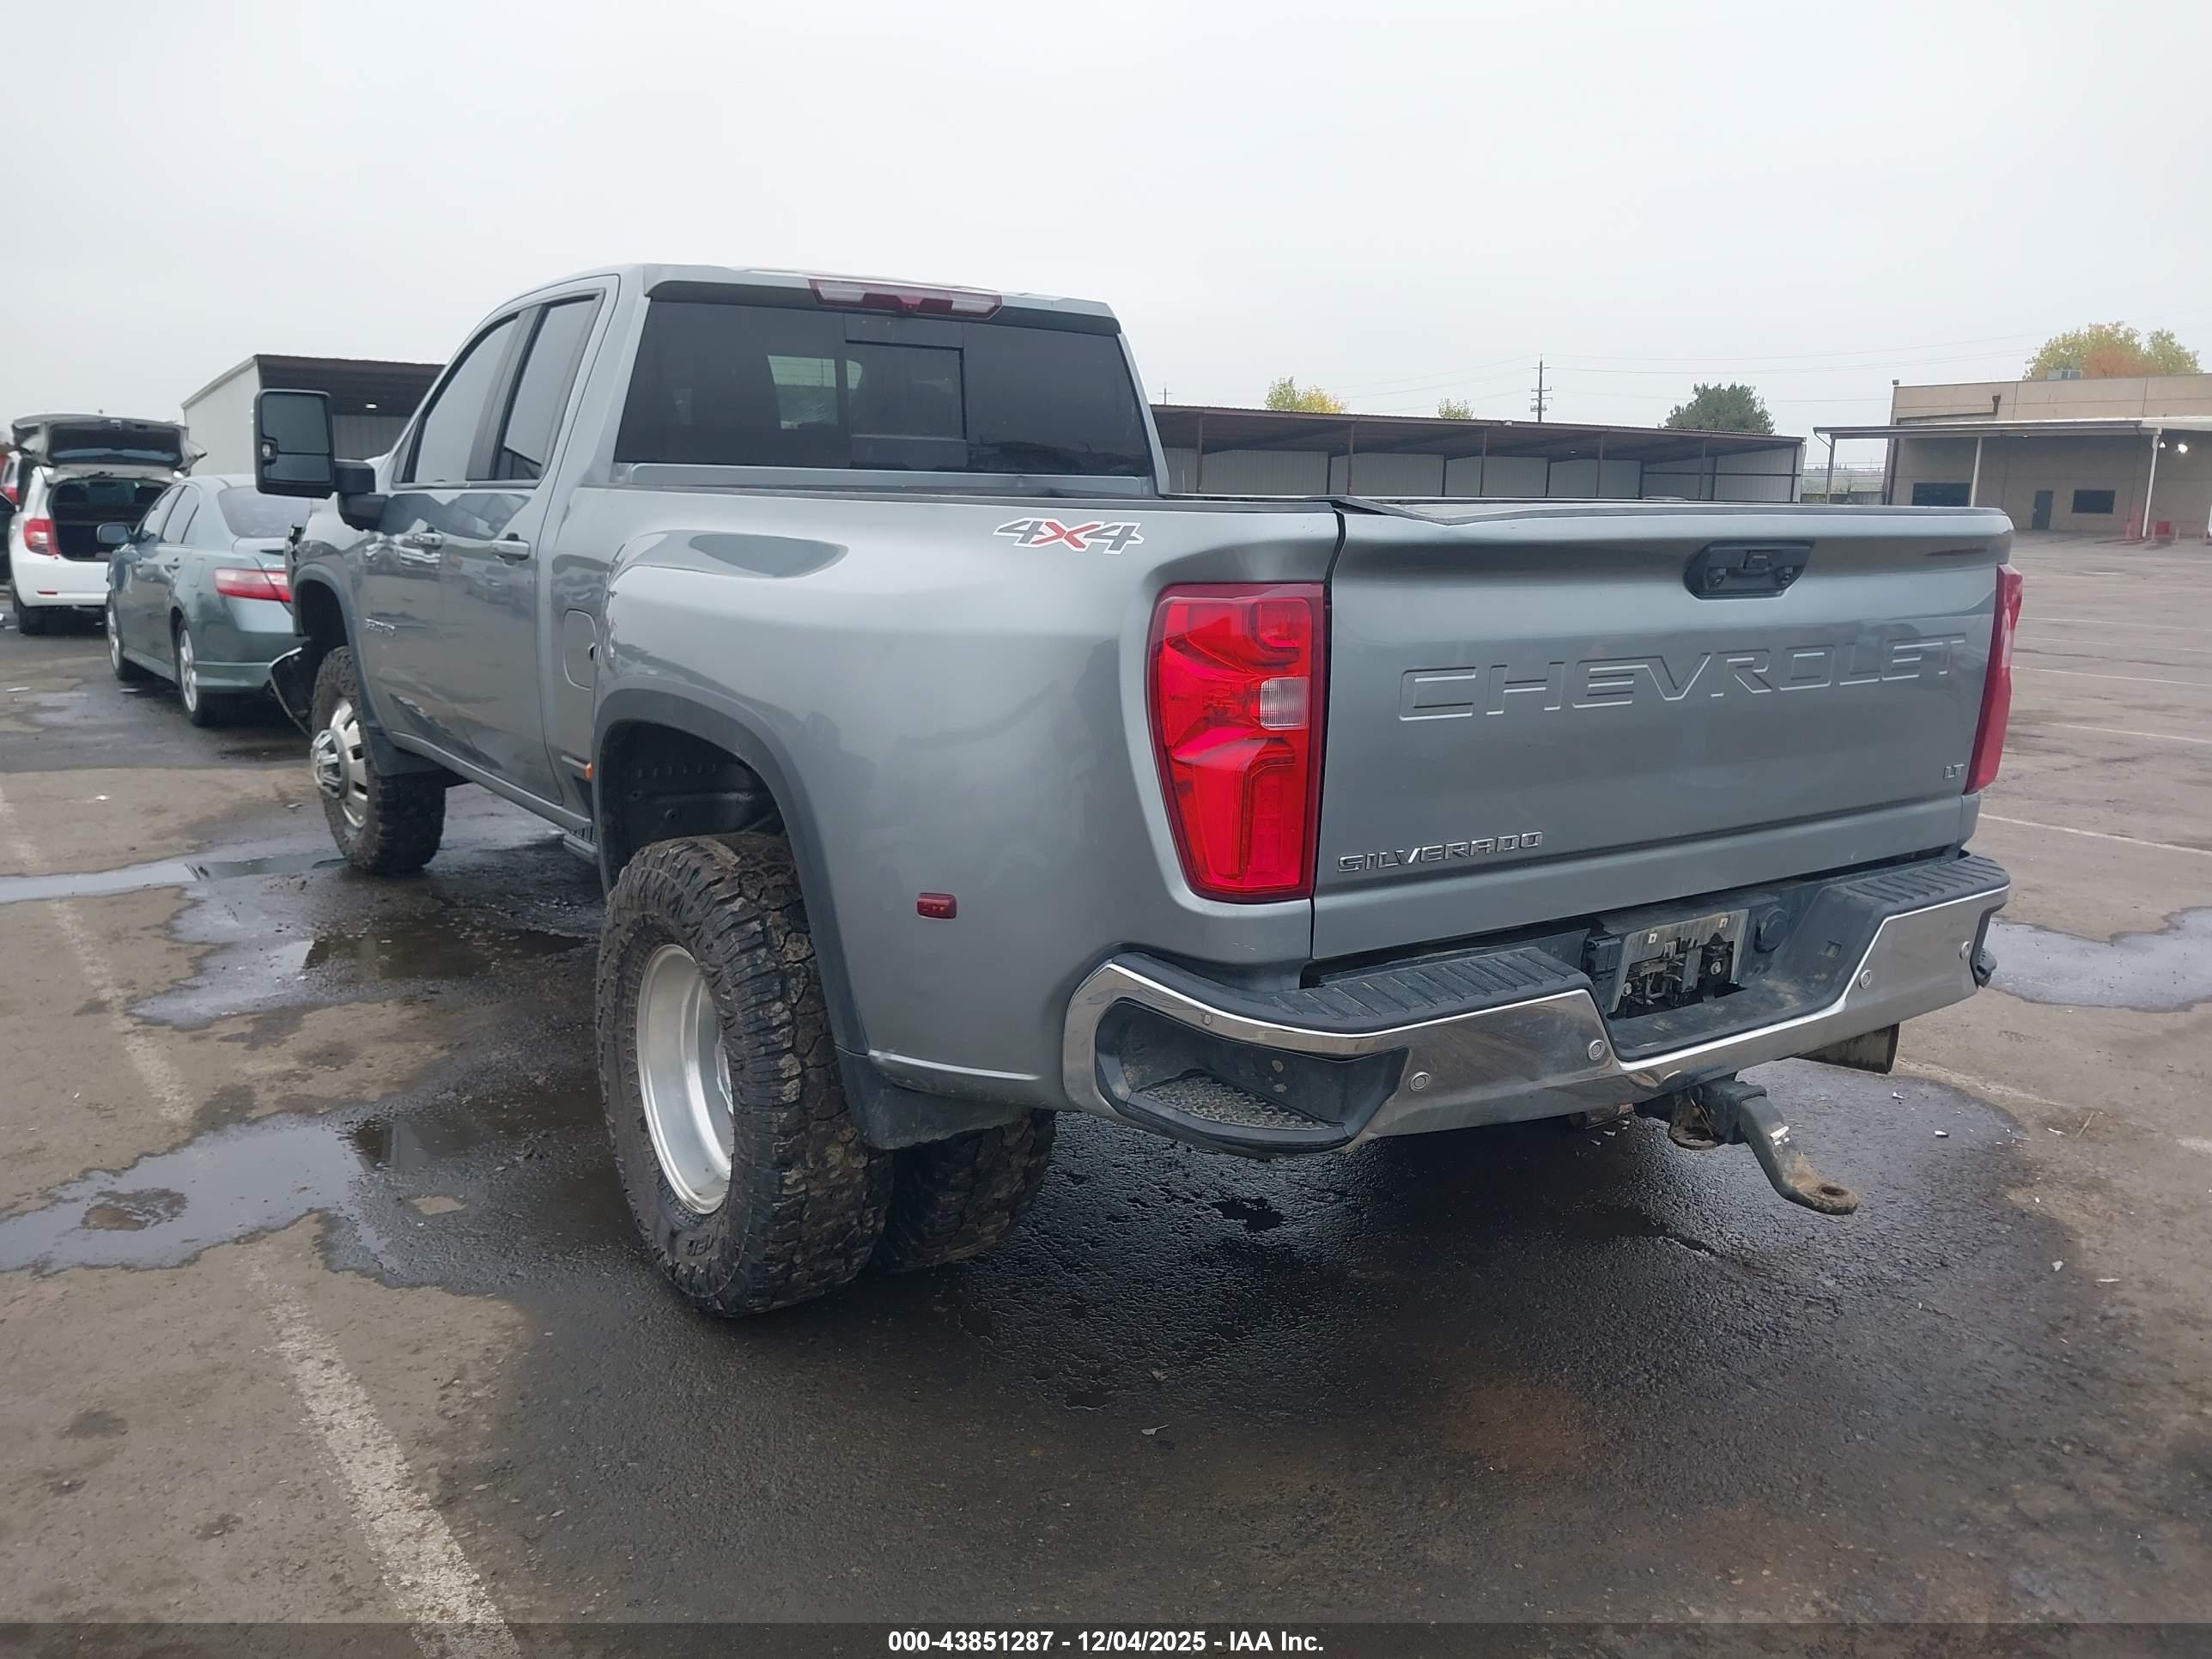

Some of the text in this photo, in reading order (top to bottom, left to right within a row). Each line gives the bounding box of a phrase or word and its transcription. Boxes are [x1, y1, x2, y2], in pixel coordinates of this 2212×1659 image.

[1399, 633, 1966, 720] CHEVROLET
[1943, 763, 1966, 780] LT
[1337, 830, 1544, 873] SILVERADO
